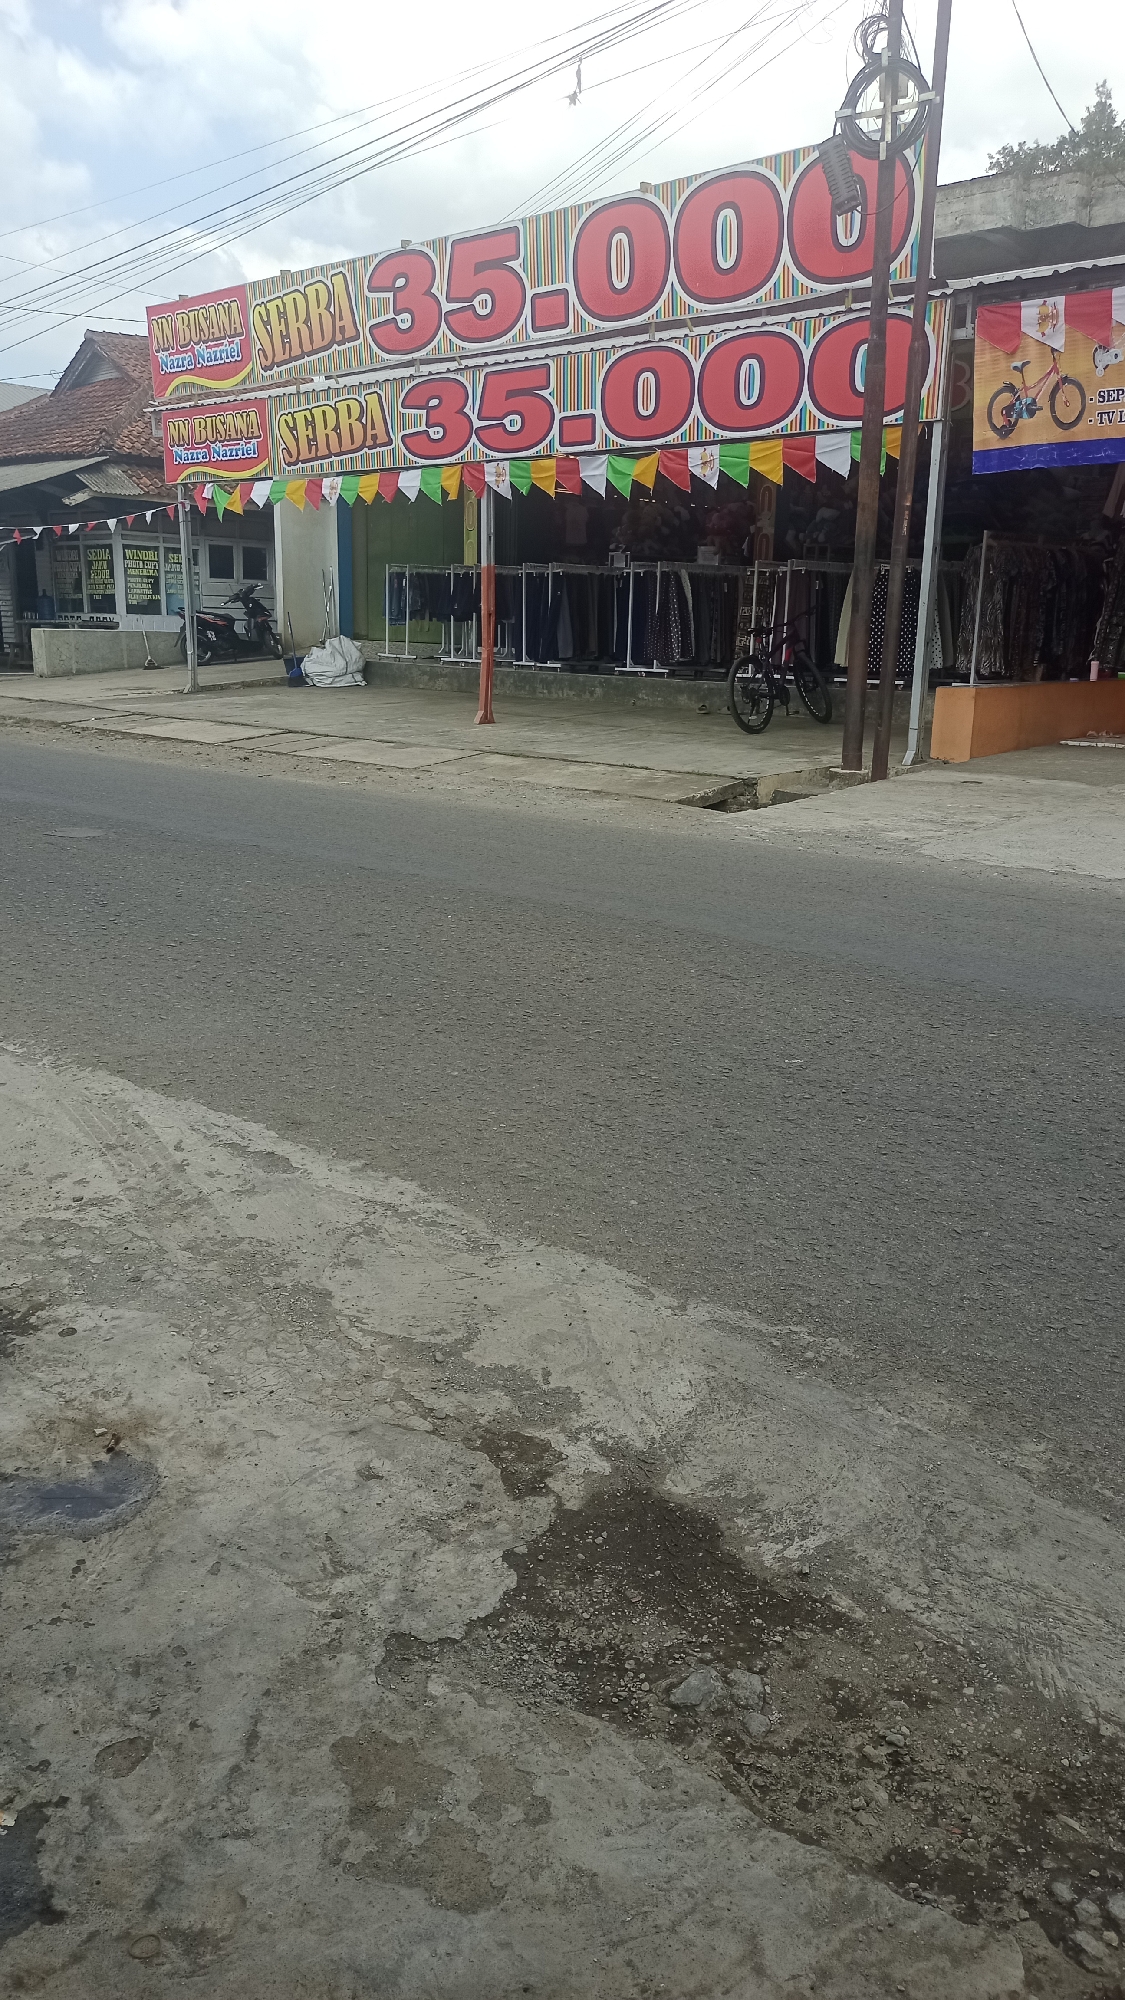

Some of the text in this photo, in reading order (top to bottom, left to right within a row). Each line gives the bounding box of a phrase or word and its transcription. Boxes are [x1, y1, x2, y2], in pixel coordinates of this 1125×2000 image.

[252, 142, 917, 372] SERBA 35.000
[151, 299, 244, 354] NN BUSANA
[160, 340, 241, 372] Nazra Nazriel
[277, 313, 931, 467] SERBA 35.000
[168, 410, 261, 447] NN BUSANA
[1097, 411, 1116, 425] TV
[174, 440, 257, 463] Nazra Nazriel
[87, 548, 111, 560] SEDIA
[124, 549, 159, 561] WINDRI
[124, 560, 143, 570] PHOTO
